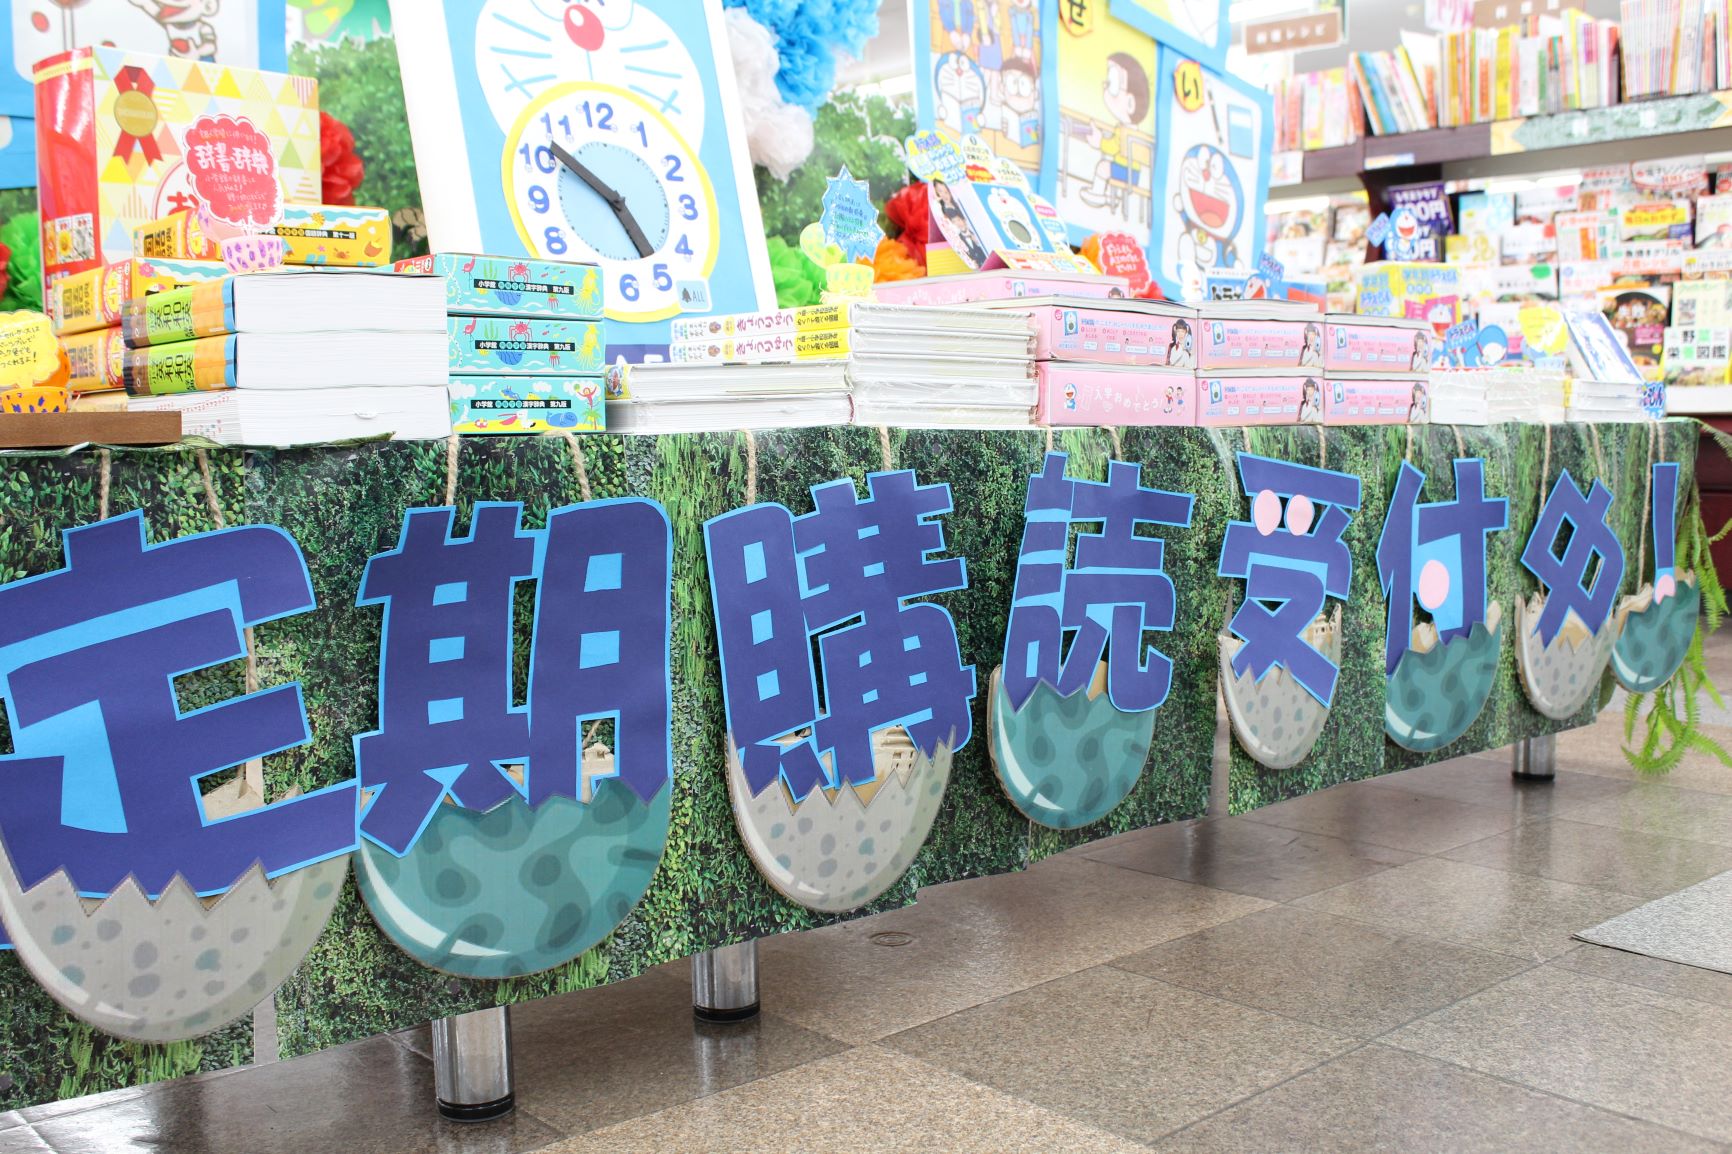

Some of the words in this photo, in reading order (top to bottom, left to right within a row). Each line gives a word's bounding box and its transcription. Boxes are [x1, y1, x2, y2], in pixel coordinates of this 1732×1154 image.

[540, 112, 574, 143] 11
[576, 100, 618, 133] 12
[630, 120, 648, 148] 1
[519, 143, 557, 174] 10
[661, 154, 684, 182] 2
[528, 184, 550, 214] 9
[678, 194, 699, 221] 3
[544, 226, 568, 255] 8
[674, 234, 694, 262] 4
[619, 274, 640, 302] 6
[653, 263, 673, 291] 5
